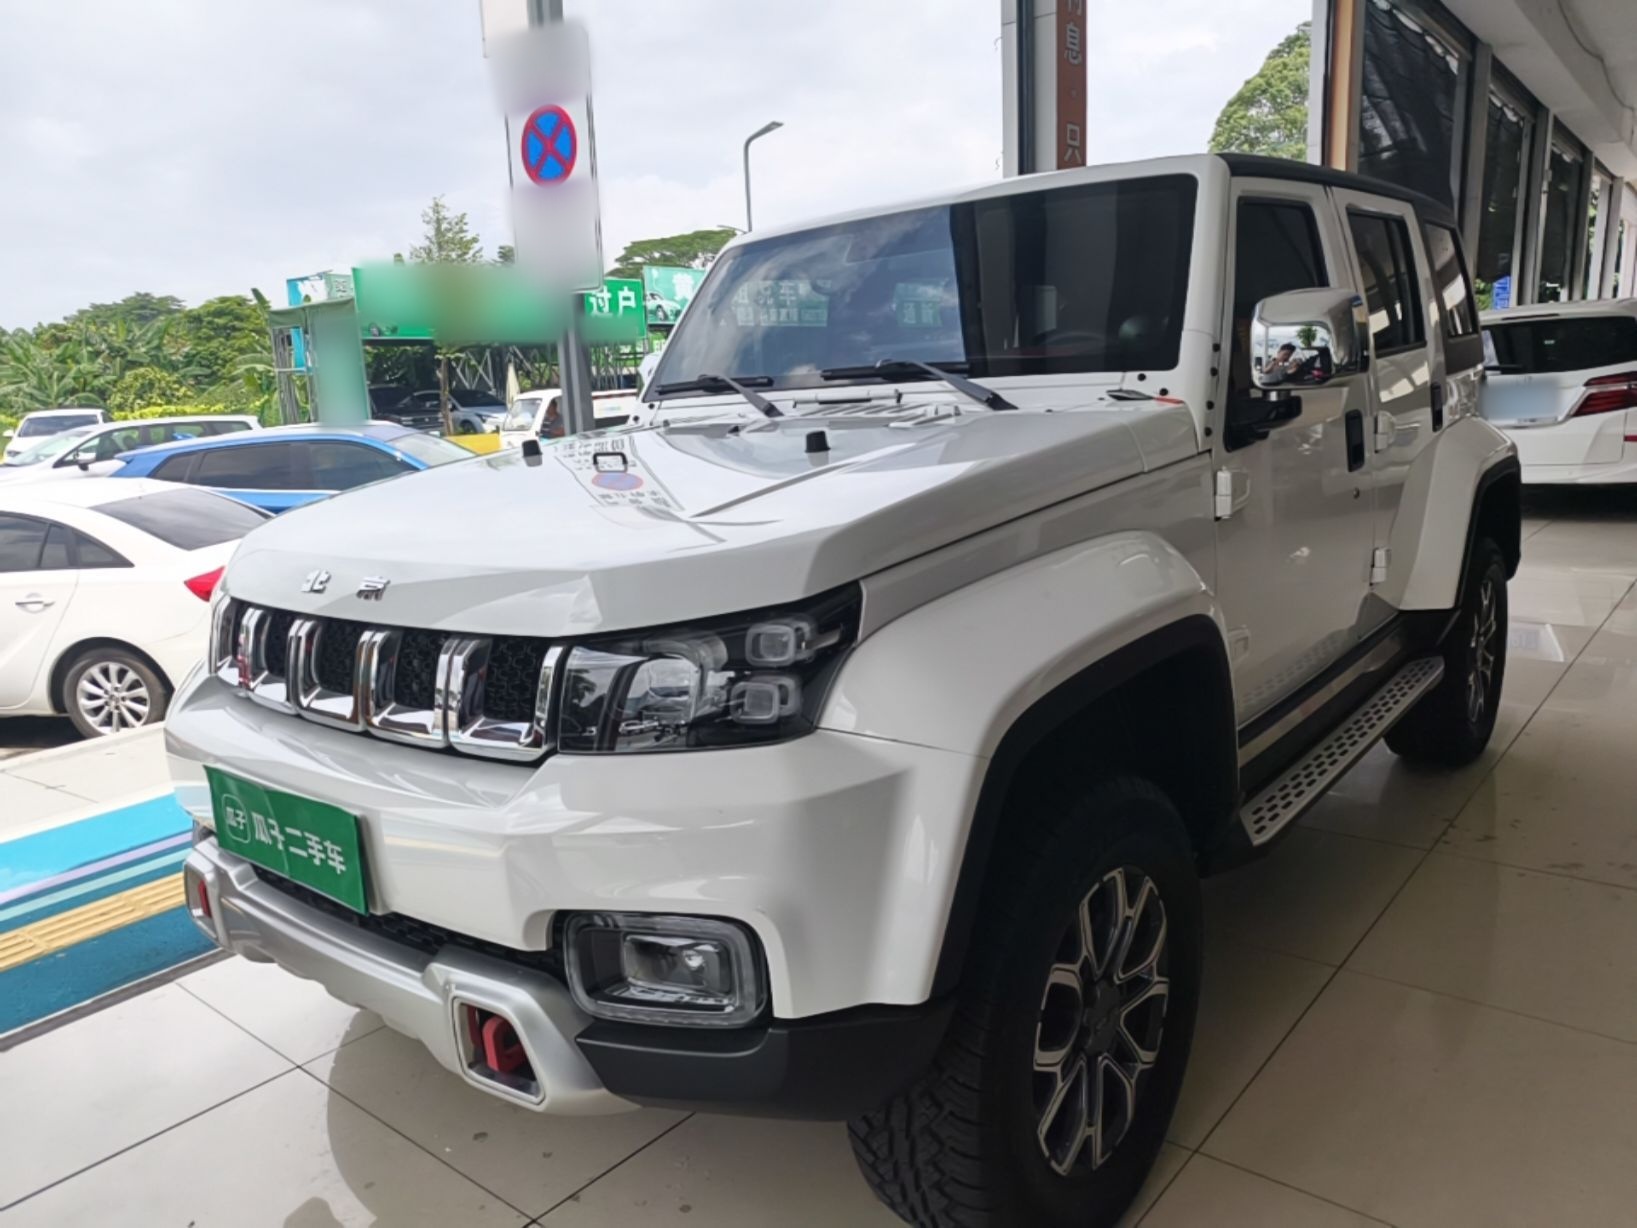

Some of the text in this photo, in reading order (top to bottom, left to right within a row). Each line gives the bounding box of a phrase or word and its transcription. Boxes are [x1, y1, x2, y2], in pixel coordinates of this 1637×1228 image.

[301, 569, 391, 601] 北京
[251, 811, 347, 875] 瓜子二手车
